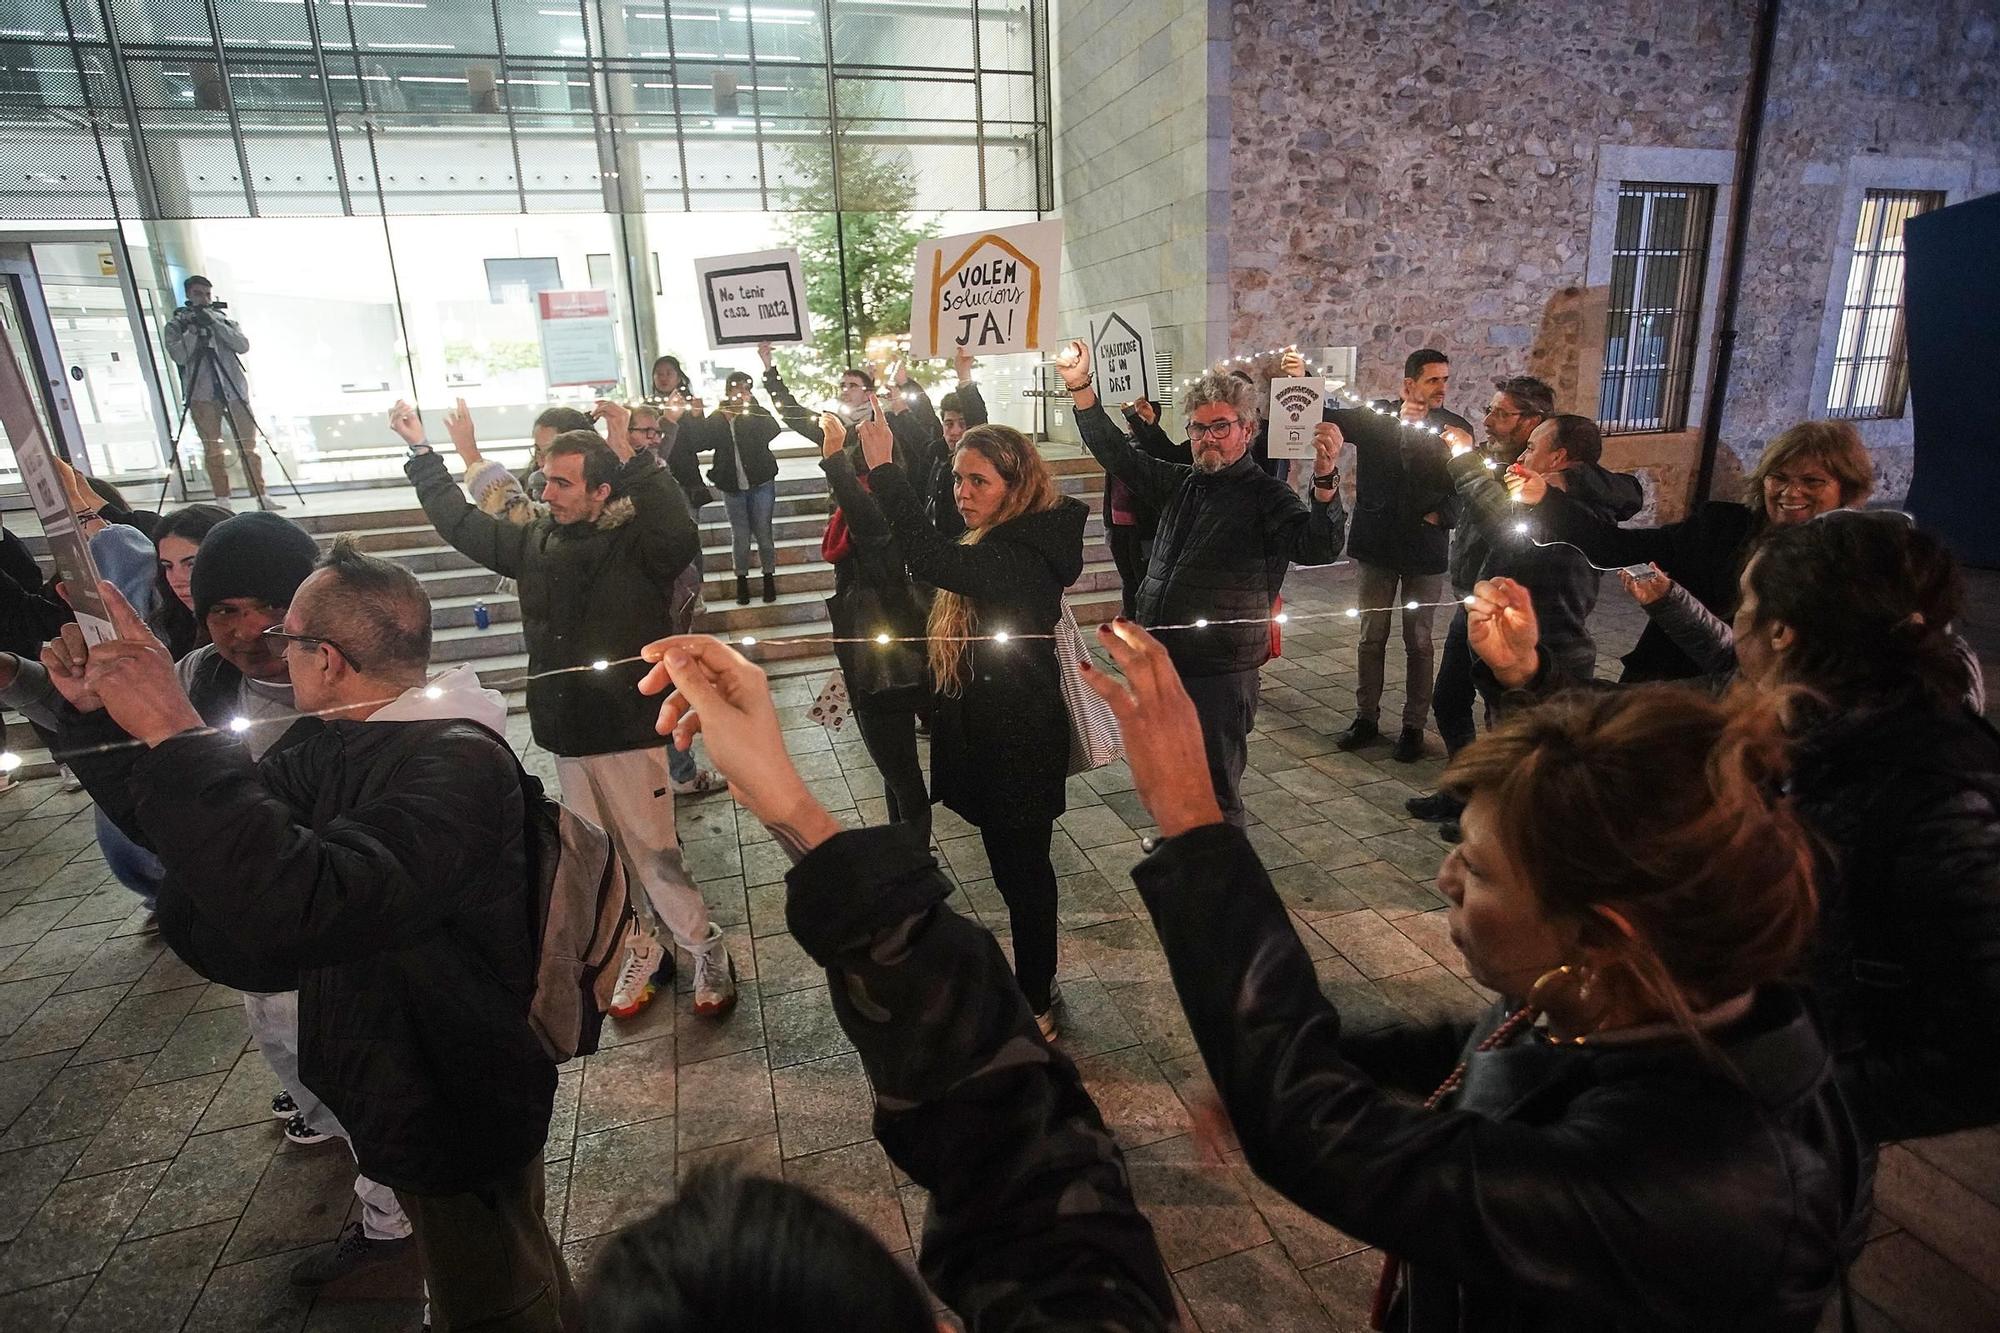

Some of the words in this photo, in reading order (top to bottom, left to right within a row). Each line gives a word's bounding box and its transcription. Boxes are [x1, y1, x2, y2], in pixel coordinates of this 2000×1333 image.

[958, 260, 1017, 288] VOLEM
[719, 287, 735, 302] No
[739, 285, 766, 299] tenir
[943, 286, 1024, 311] Solucions
[723, 306, 750, 319] casa
[758, 300, 790, 319] mata
[955, 309, 1013, 346] JA!
[1109, 375, 1131, 393] DRET
